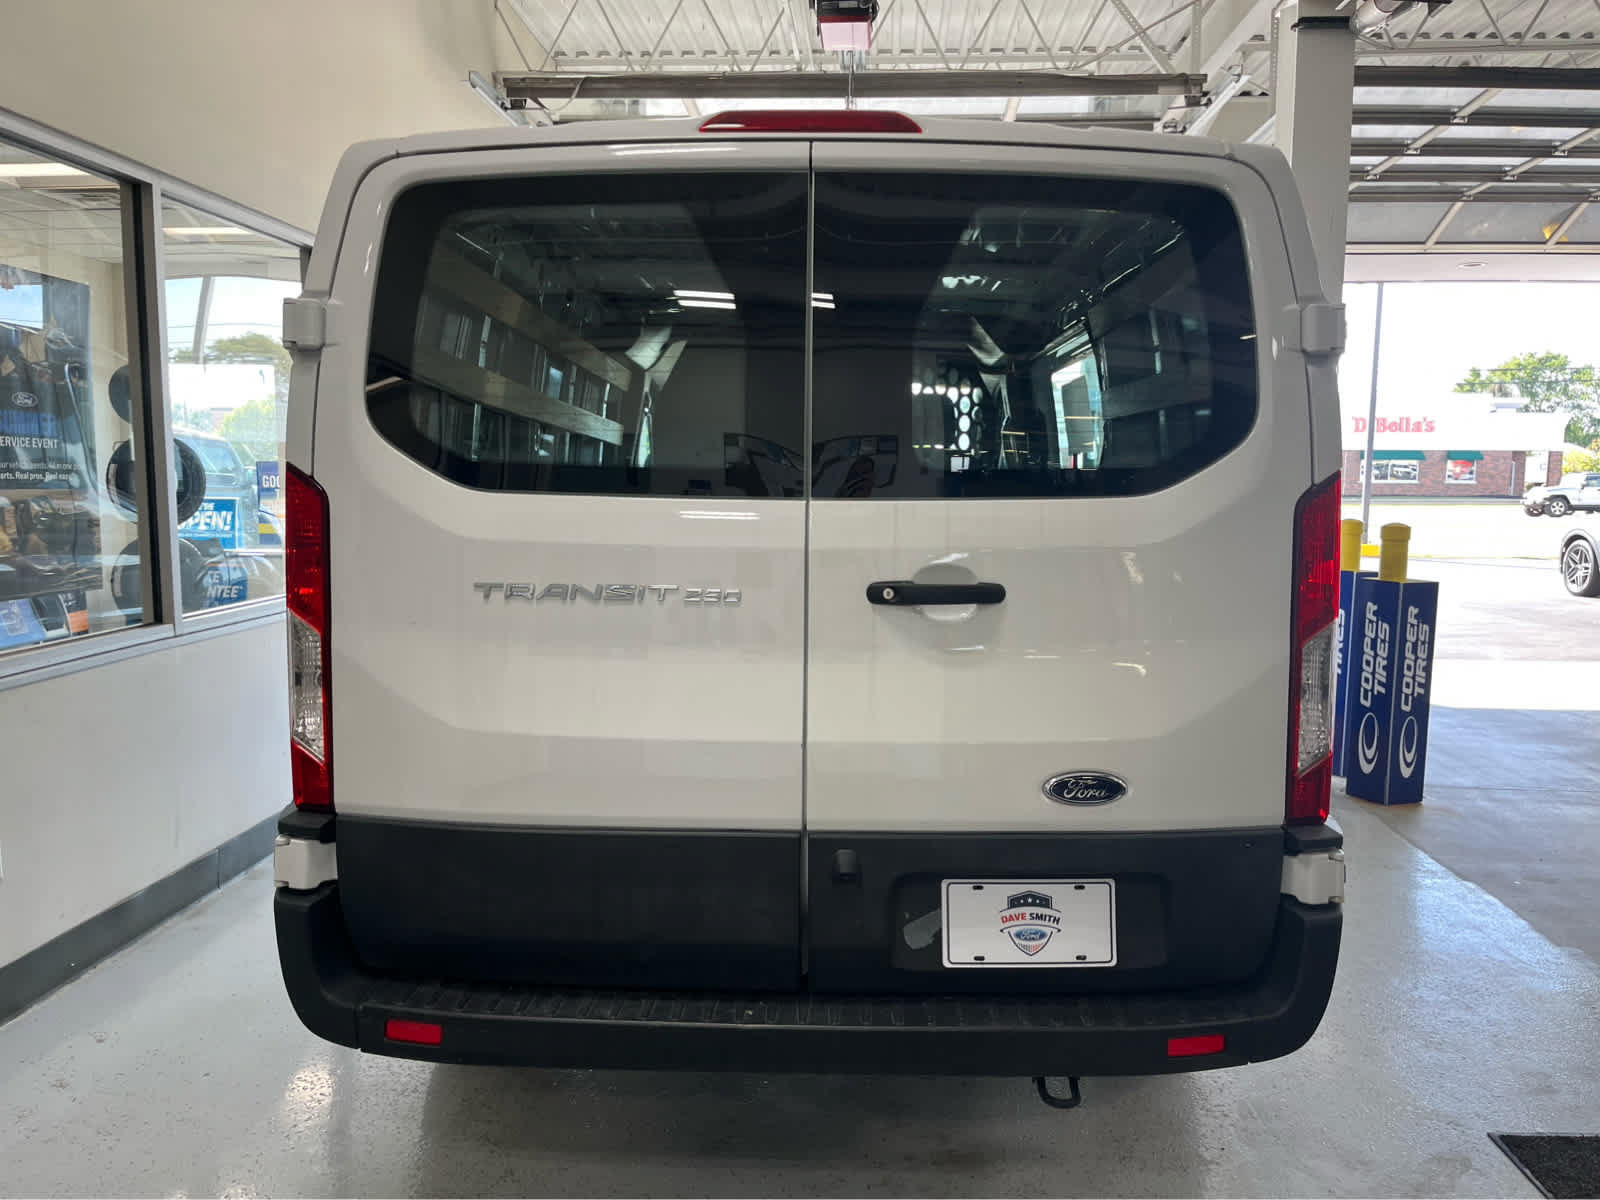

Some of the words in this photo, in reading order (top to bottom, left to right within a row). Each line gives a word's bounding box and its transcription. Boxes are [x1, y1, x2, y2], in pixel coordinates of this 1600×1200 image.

[1352, 416, 1436, 433] DBella's
[0, 436, 31, 448] ERVICE
[32, 438, 57, 449] EVENT
[0, 472, 15, 480] arts.
[473, 582, 680, 602] TRANSIT
[684, 588, 742, 603] 250
[1360, 601, 1378, 708] COOPER
[1374, 620, 1390, 695] TIRES
[1401, 605, 1419, 713] COOPER
[1414, 622, 1430, 697] TIRES
[1001, 912, 1027, 924] DAVE
[1029, 912, 1061, 926] SMITH
